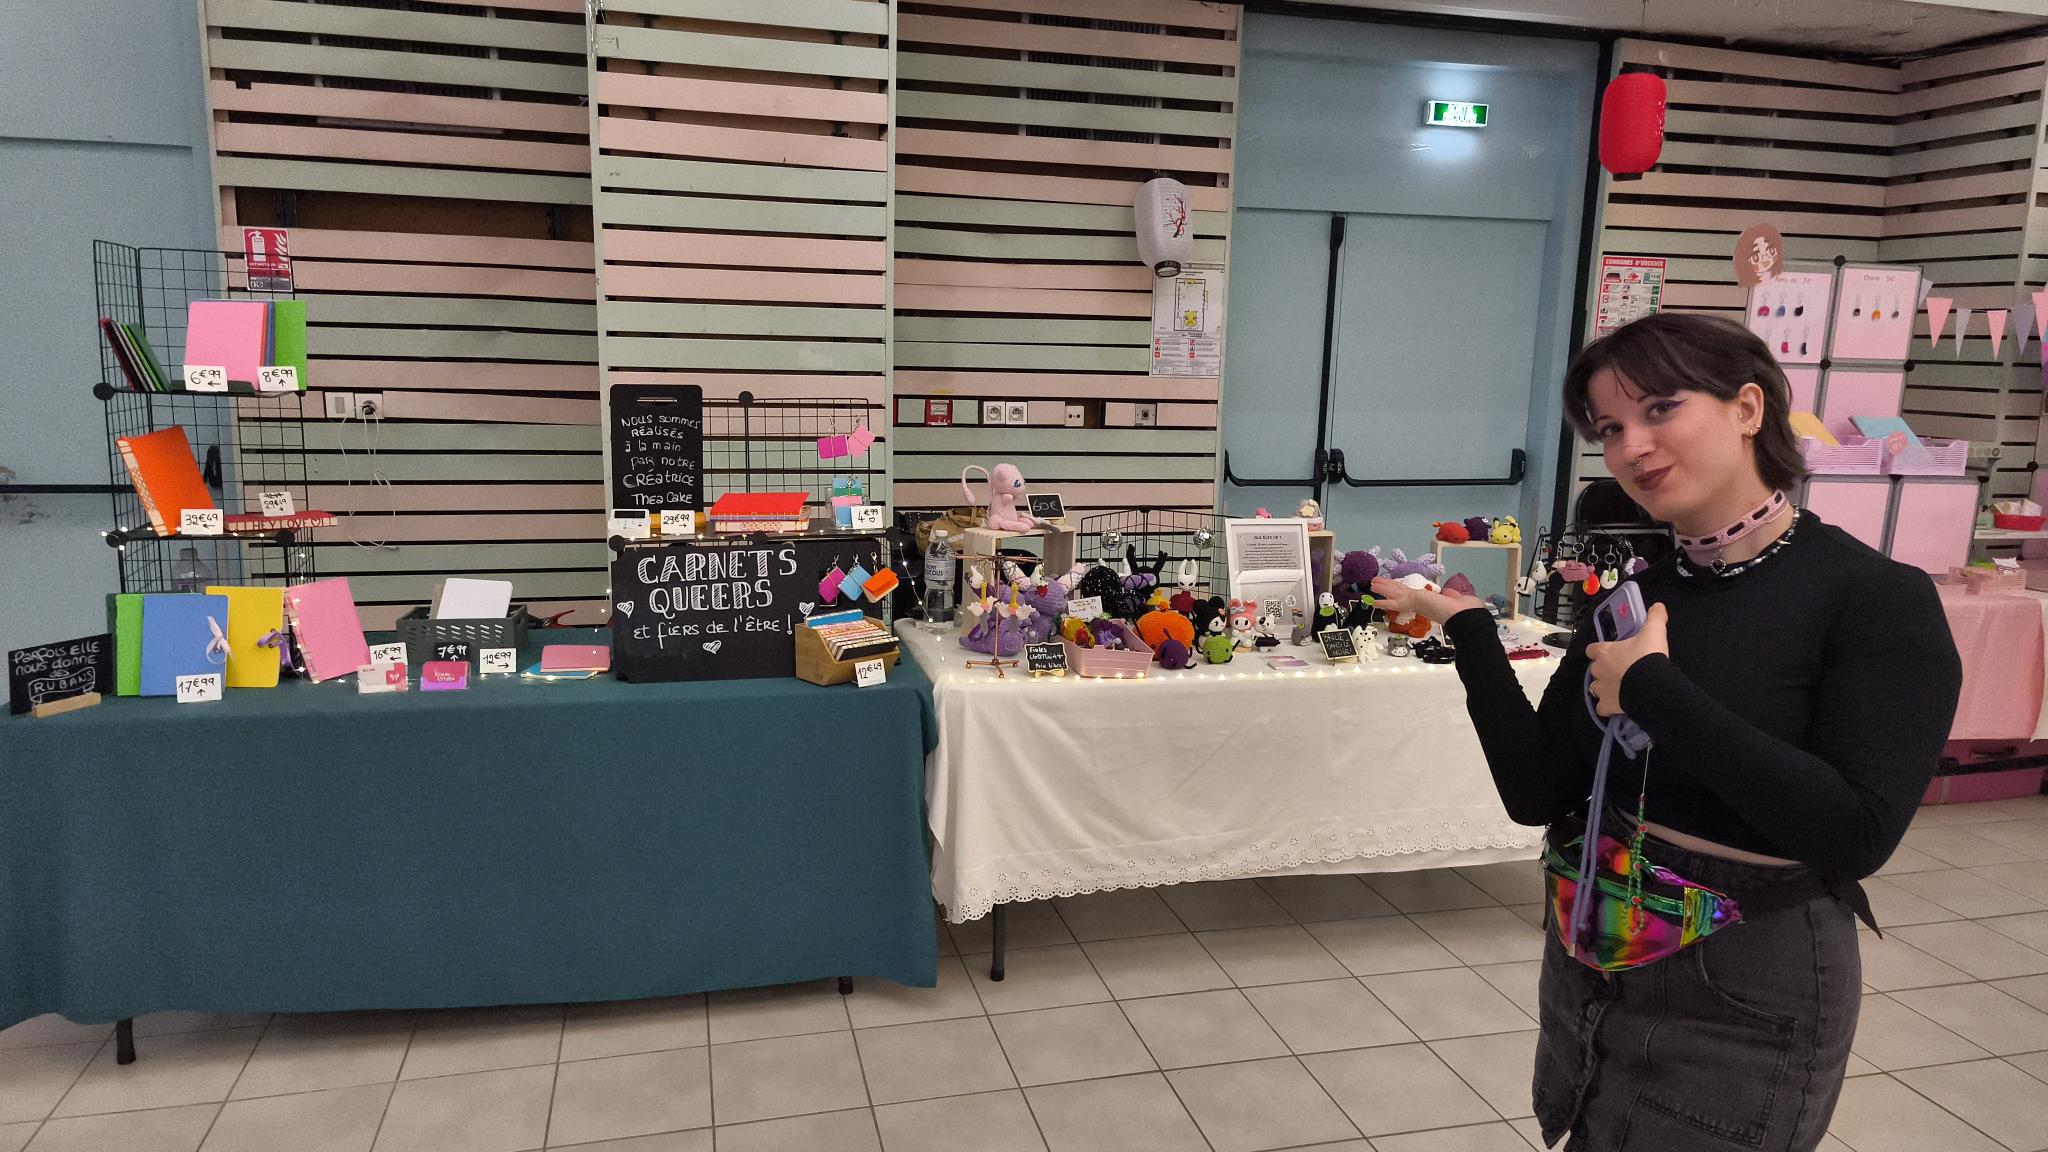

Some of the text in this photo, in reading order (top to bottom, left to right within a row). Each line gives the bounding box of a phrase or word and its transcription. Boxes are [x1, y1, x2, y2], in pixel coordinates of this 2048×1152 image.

[190, 369, 221, 385] 6€99
[262, 369, 293, 383] 8€99
[638, 440, 647, 451] la
[653, 441, 681, 451] main
[1032, 499, 1060, 512] 60€
[663, 513, 690, 525] 29€99
[857, 508, 879, 524] 4€99
[637, 549, 798, 584] CARNETS
[649, 579, 773, 620] QUEERS
[373, 646, 401, 660] 16€99
[438, 645, 467, 658] 7€99
[482, 651, 512, 665] 12€99
[857, 662, 882, 679] 12€49
[34, 670, 94, 693] RUBANS
[179, 677, 214, 694] 17€99
